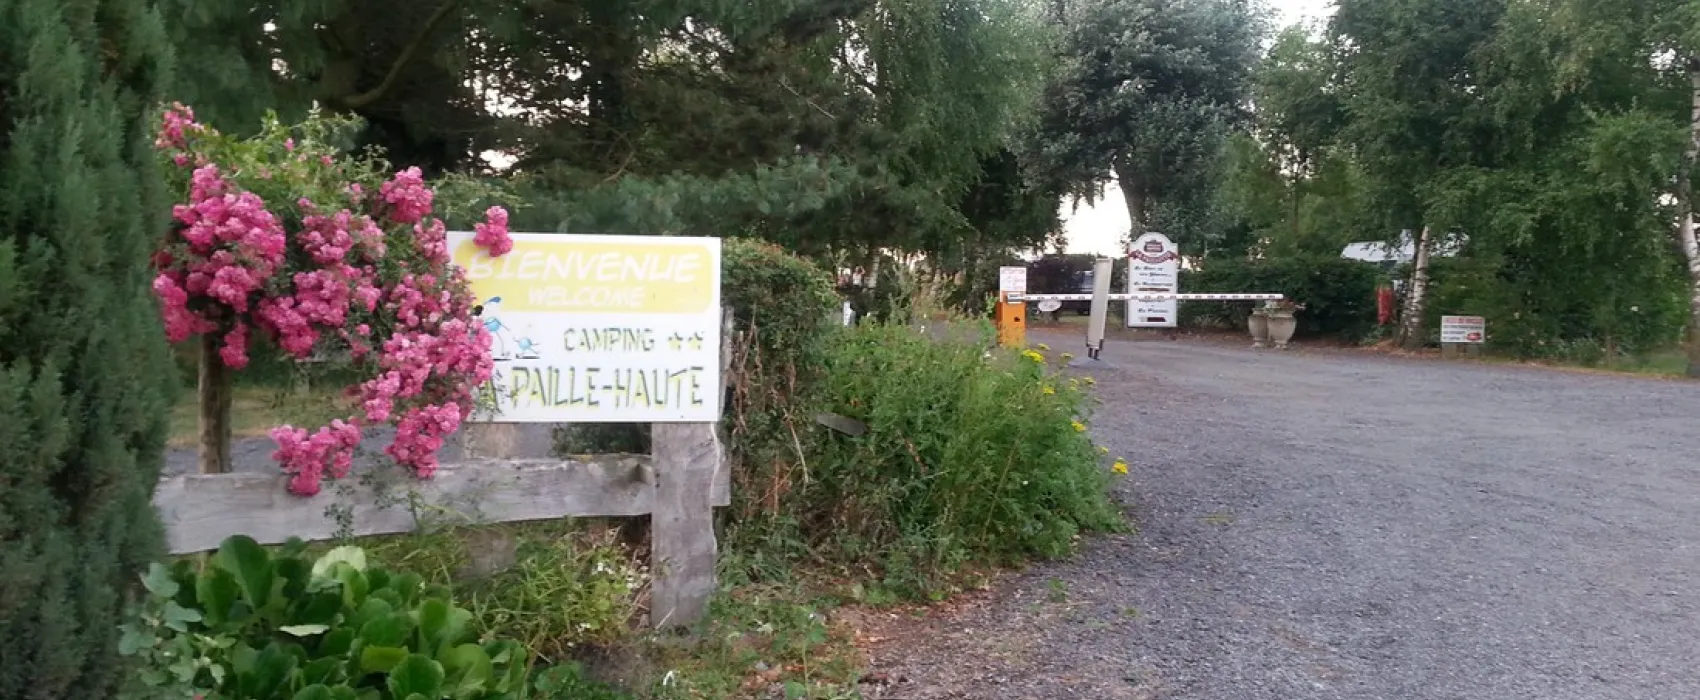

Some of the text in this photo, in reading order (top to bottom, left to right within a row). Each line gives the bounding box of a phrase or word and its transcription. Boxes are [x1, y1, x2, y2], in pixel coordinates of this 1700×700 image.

[468, 250, 701, 282] BIENVENUE
[528, 286, 646, 307] WELCOME
[563, 327, 655, 352] CAMPING
[511, 366, 705, 409] PAILLE-HAUTE
